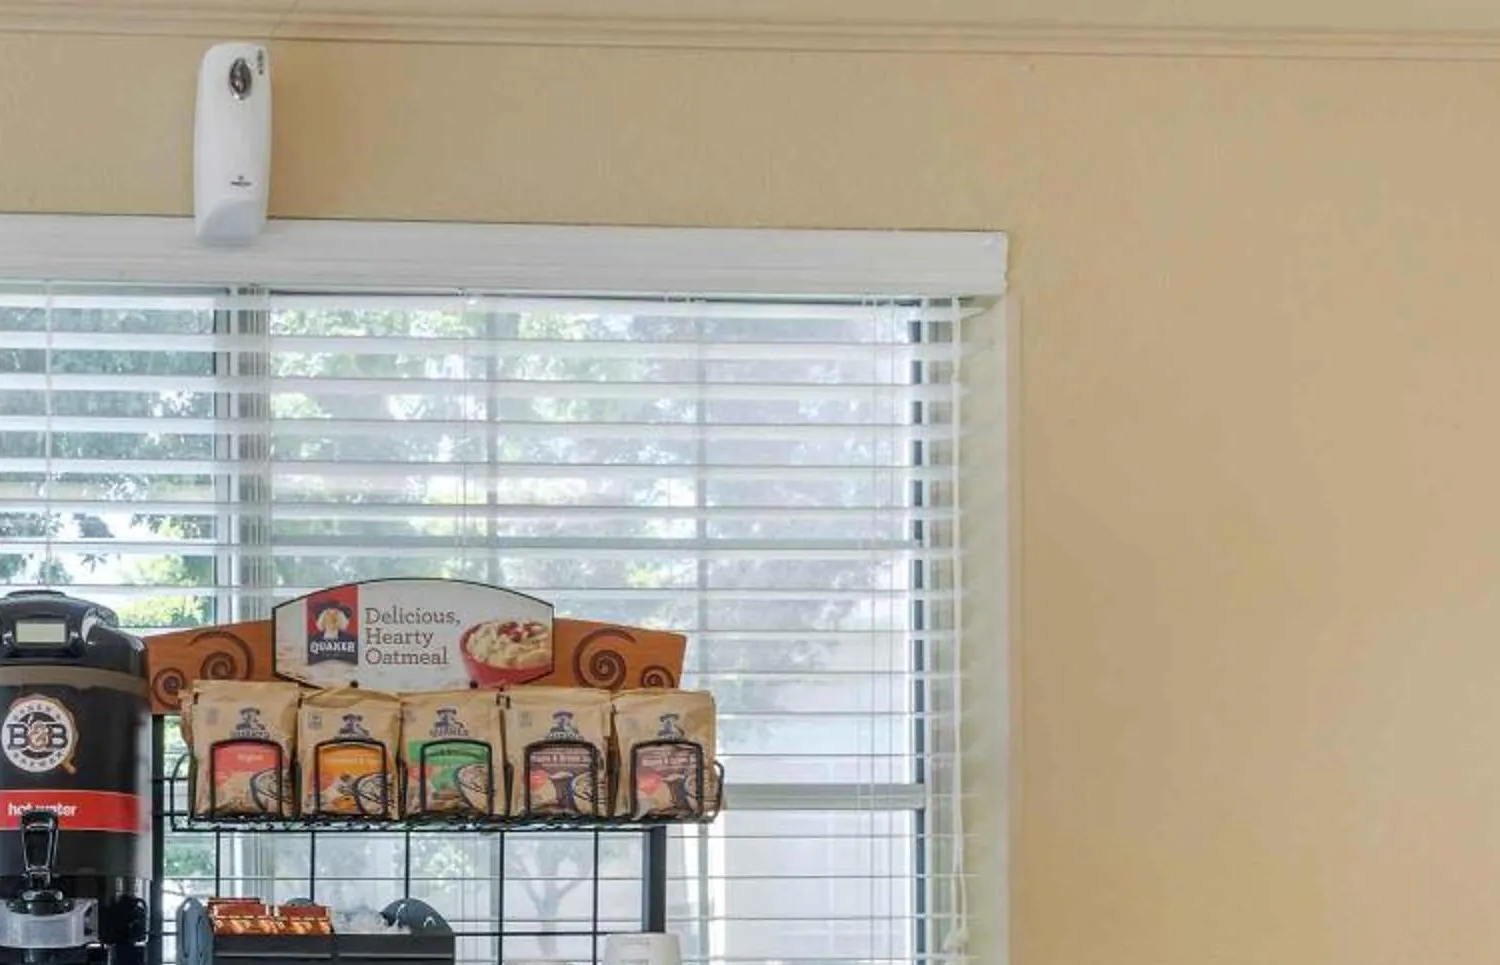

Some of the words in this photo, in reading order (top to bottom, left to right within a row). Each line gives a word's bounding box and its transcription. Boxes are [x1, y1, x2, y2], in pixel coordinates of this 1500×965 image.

[365, 605, 461, 625] Delicious,
[365, 628, 434, 648] Hearty
[310, 641, 356, 654] QUAKER
[365, 647, 449, 665] Oatmeal
[7, 801, 33, 816] hot
